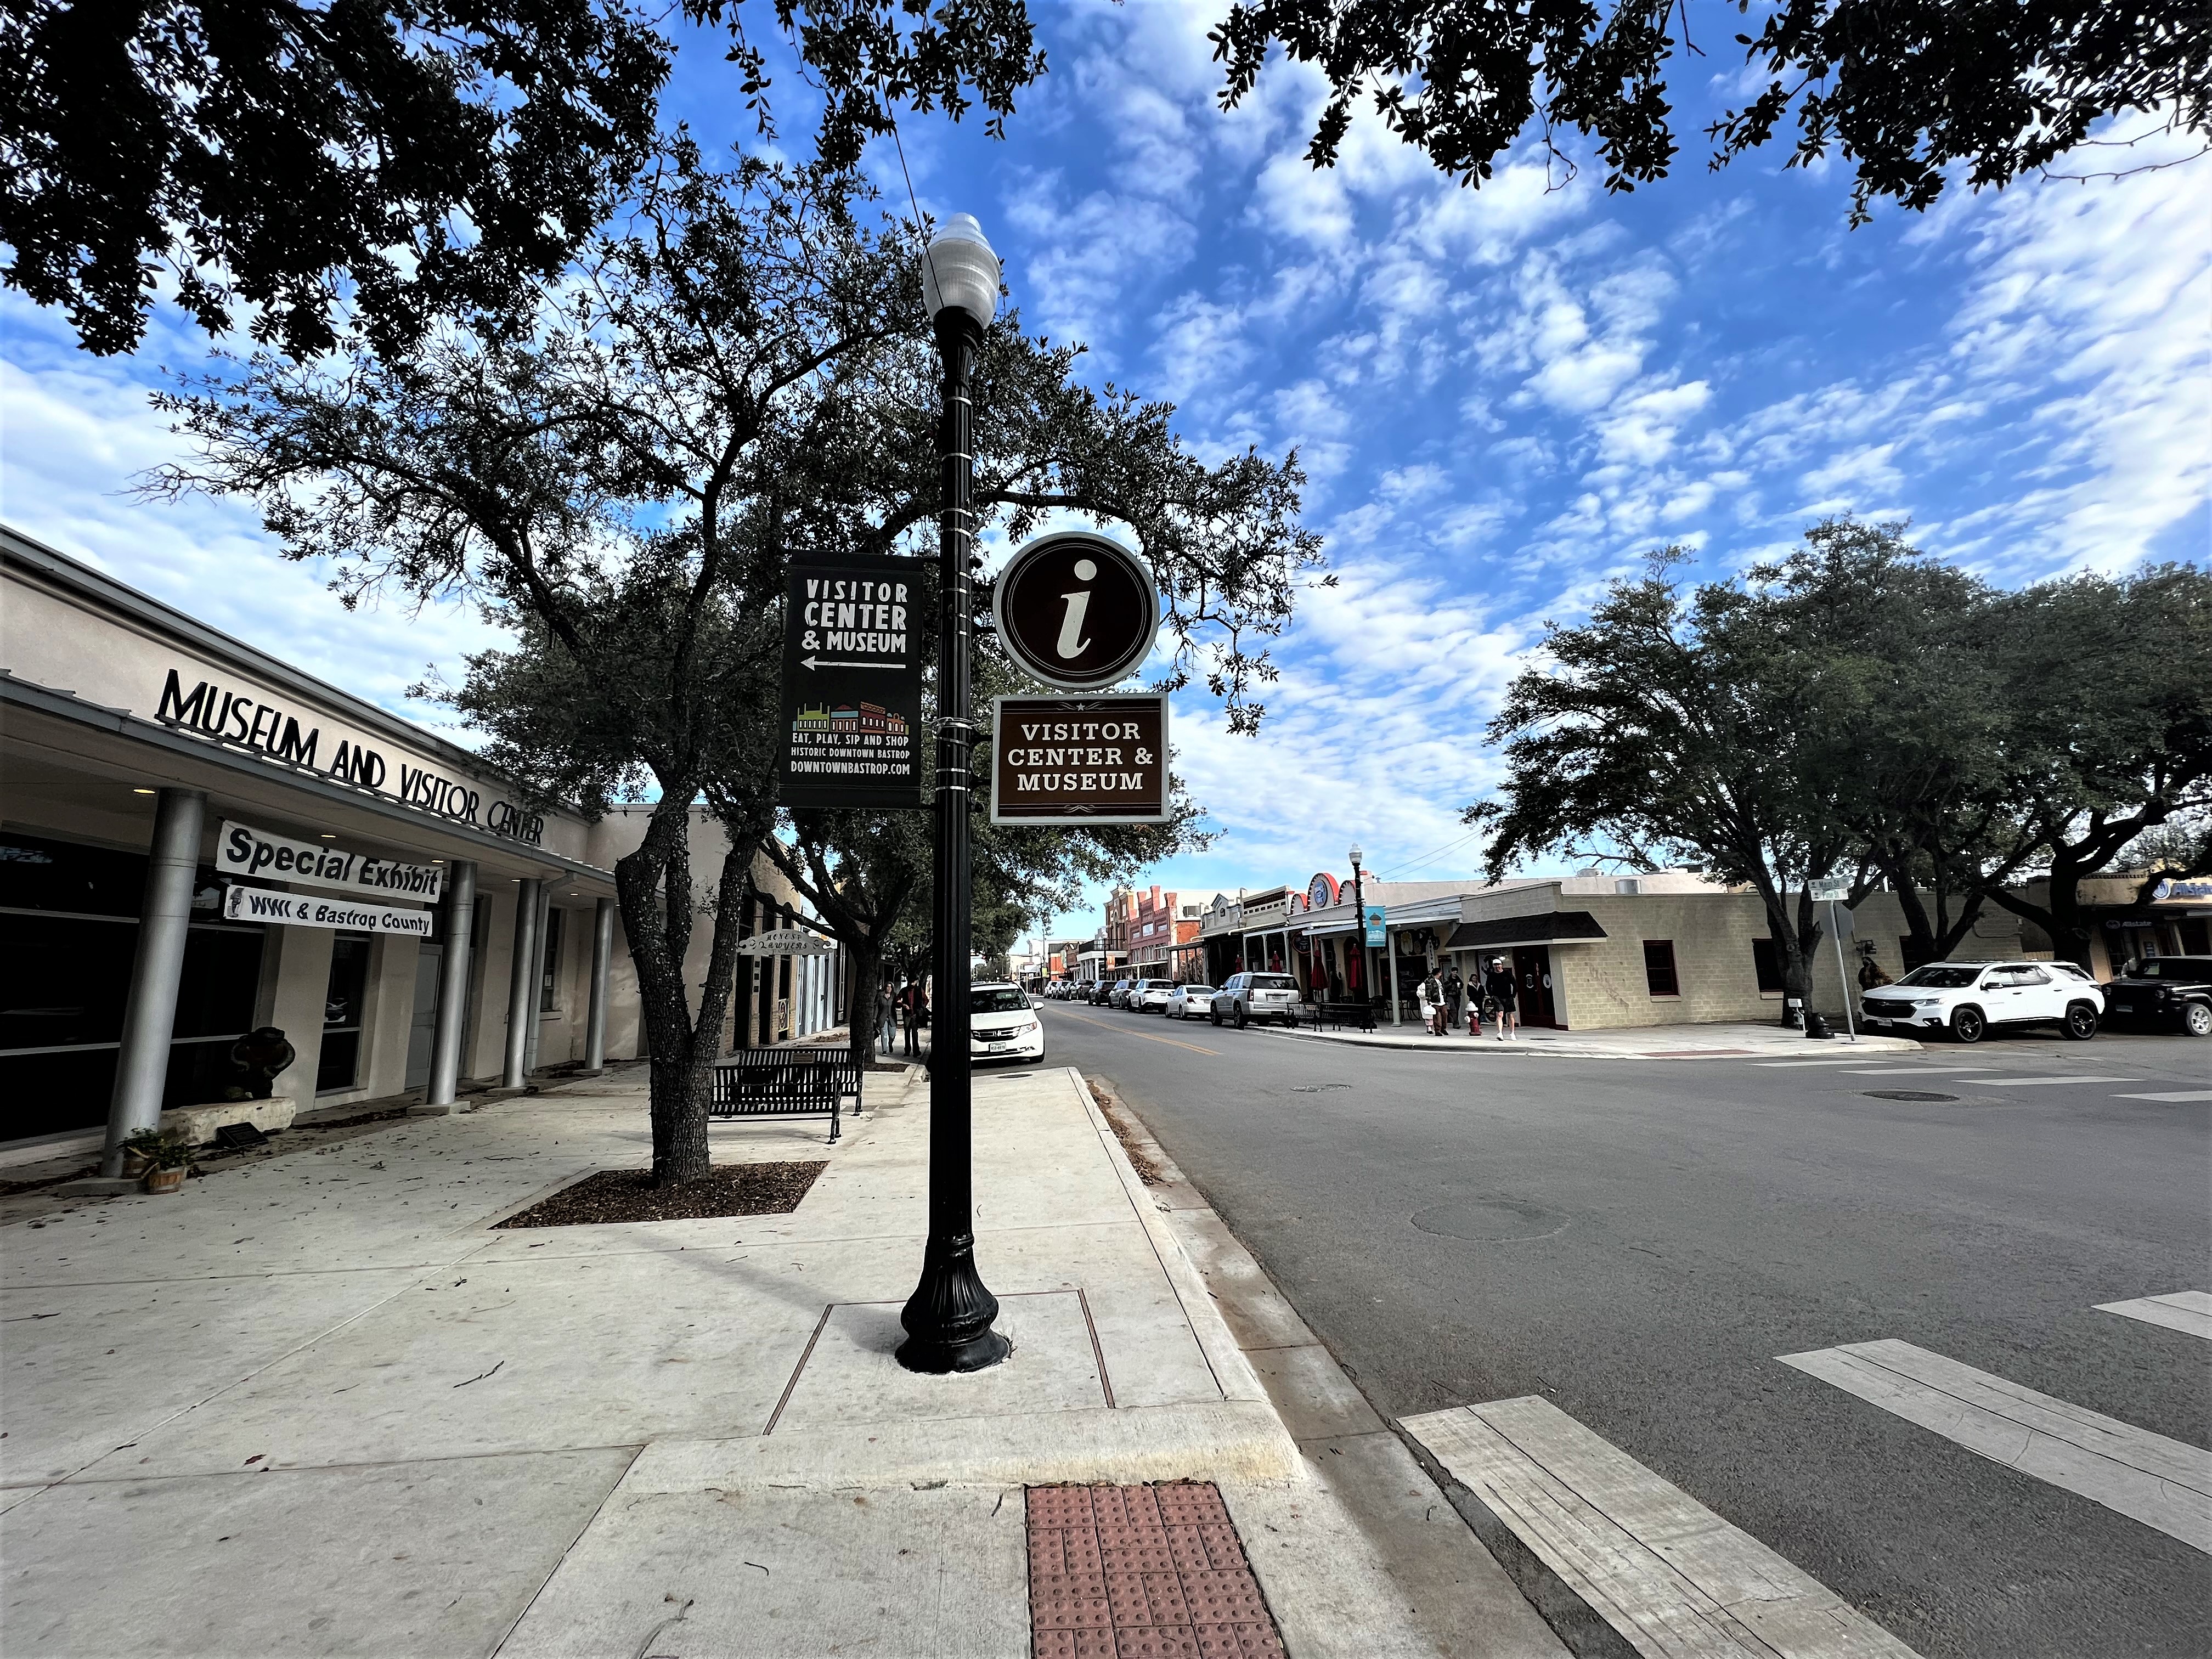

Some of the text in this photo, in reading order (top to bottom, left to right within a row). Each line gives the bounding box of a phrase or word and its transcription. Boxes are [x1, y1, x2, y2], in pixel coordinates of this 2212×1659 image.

[807, 579, 907, 602] VISITOR
[805, 602, 906, 630] CENTER
[802, 630, 906, 653] & MUSEUM
[792, 733, 909, 746] EAT, PLAY, SIP AND SHOP
[1021, 723, 1141, 741] VISITOR
[157, 668, 319, 766] MUSEUM
[330, 740, 385, 788] AND
[401, 763, 479, 823] VISITOR
[791, 747, 910, 759] HISTORIC DOWNTOWN BASTROP
[1008, 747, 1153, 766] CENTER &
[791, 761, 910, 775] DOWNTOWNBASTROP.COM
[1017, 772, 1143, 791] MUSEUM
[227, 828, 438, 895] Special Exhibit
[2172, 883, 2212, 895] Allstat
[249, 895, 430, 934] WWI & Bastrop County
[759, 941, 808, 950] LAWYERS
[766, 933, 802, 941] HONEST
